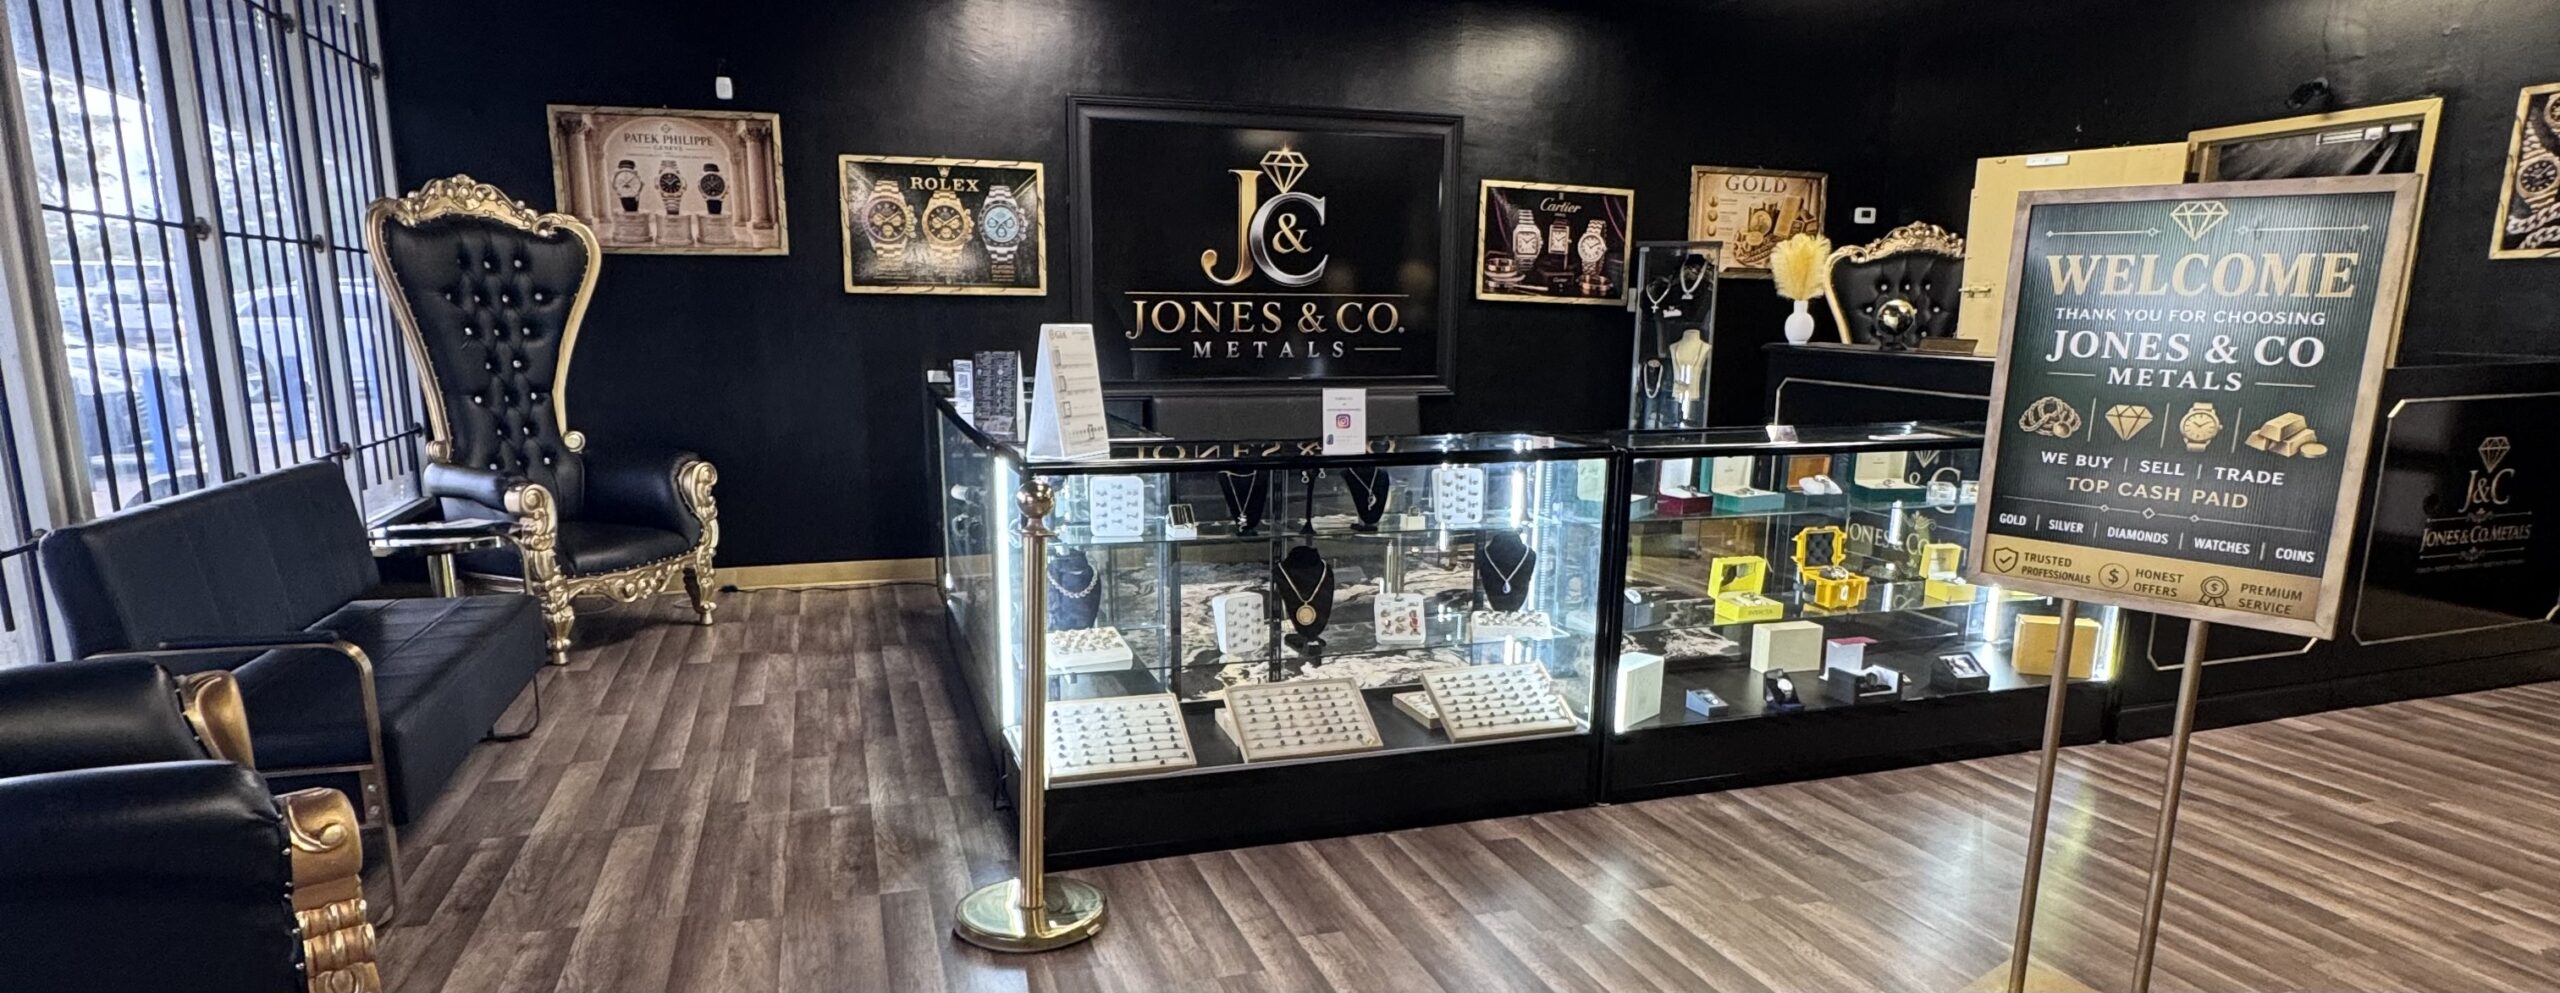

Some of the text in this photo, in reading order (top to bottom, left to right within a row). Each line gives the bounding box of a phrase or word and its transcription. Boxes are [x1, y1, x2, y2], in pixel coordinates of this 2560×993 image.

[623, 132, 713, 147] PATEK PHILIPPE
[910, 176, 980, 193] ROLEX
[1725, 174, 1788, 194] GOLD
[1540, 197, 1582, 214] Cartier
[2046, 251, 2359, 299] WELCOME
[1125, 300, 1406, 339] JONES & CO.
[2054, 307, 2327, 327] THANK YOU FOR CHOOSING
[1192, 340, 1345, 359] METALS
[2045, 329, 2325, 368] JONES & CO
[2106, 366, 2243, 392] METALS
[2040, 450, 2286, 486] WE BUY SELL TRADE
[2066, 476, 2249, 509] TOP CASH PAID
[2457, 468, 2516, 513] J&C
[1999, 512, 2316, 564] GOLD SILVER DIAMONDS WATCHES COINS
[2023, 551, 2073, 568] TRUSTED
[2020, 565, 2092, 585] PROFESSIONALS
[2135, 567, 2185, 584] HONEST
[2132, 582, 2178, 598] OFFERS
[2240, 582, 2303, 602] PREMIUM
[2237, 598, 2294, 616] SERVICE
